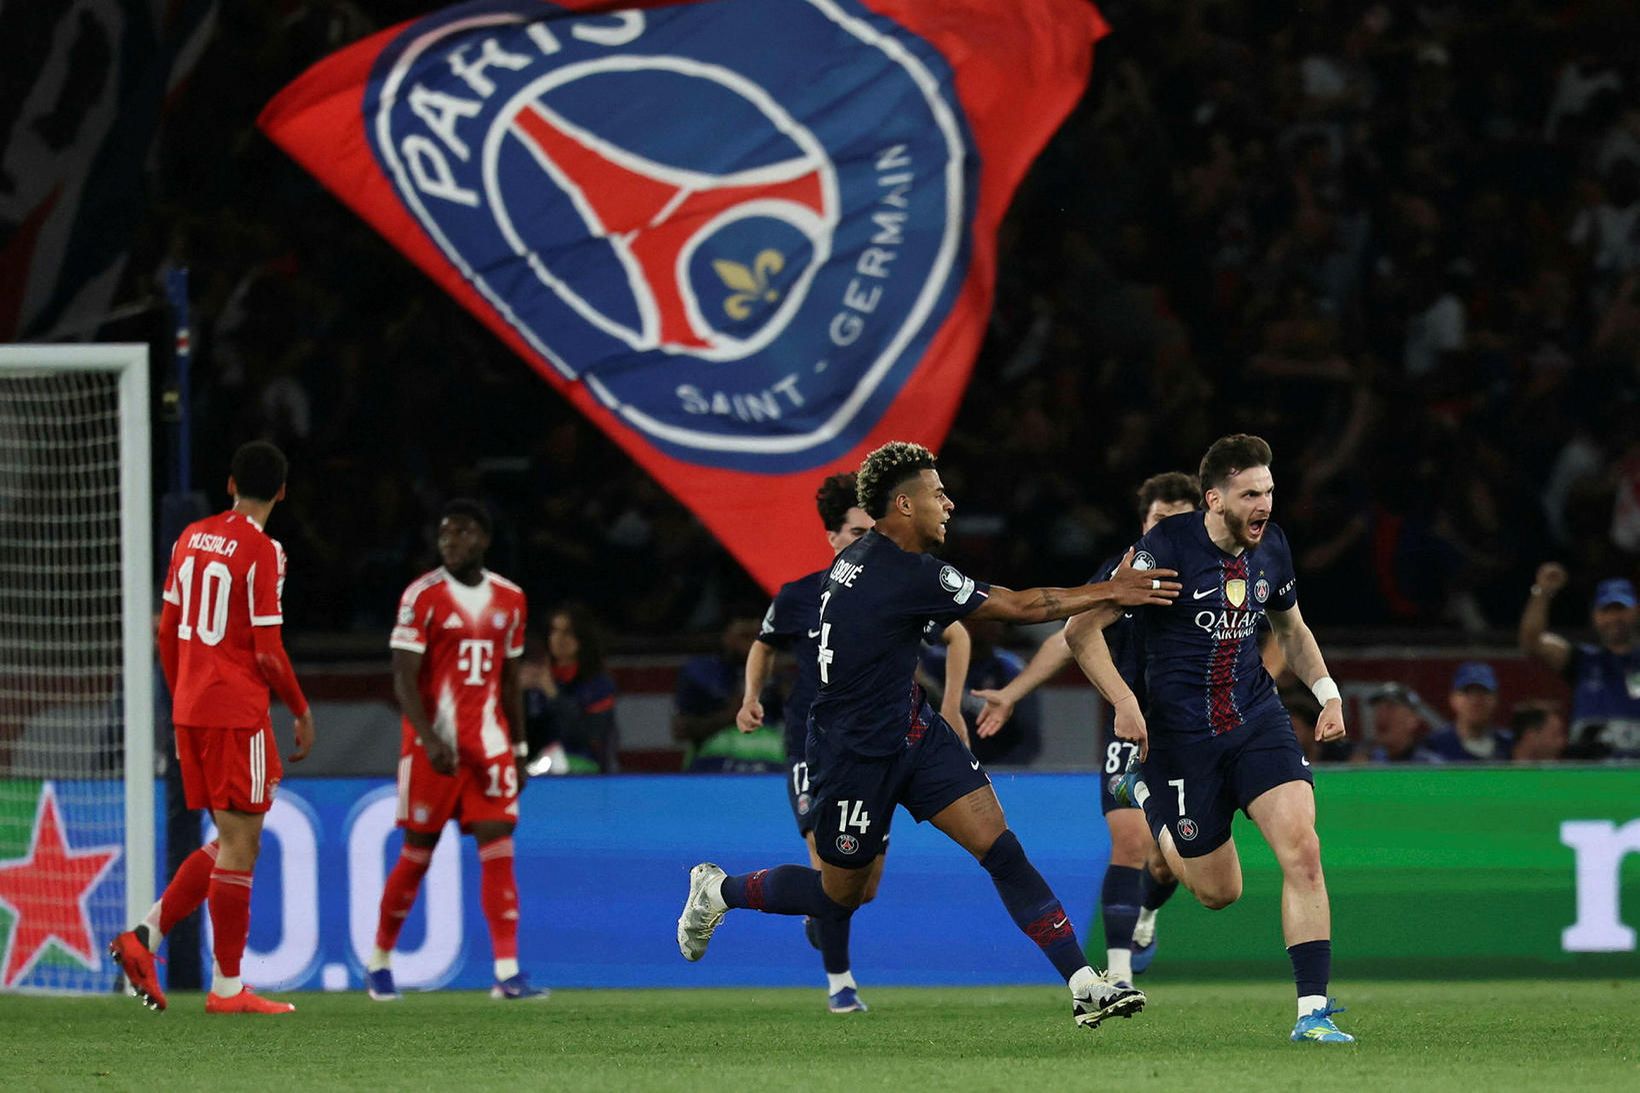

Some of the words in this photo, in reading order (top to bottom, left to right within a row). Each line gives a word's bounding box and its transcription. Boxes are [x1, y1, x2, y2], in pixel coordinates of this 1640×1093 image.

[676, 373, 804, 422] SAINT
[829, 144, 914, 346] GERMAIN
[178, 555, 232, 646] 10
[458, 639, 494, 686] T
[1105, 741, 1139, 774] 87
[486, 764, 518, 798] 19
[1168, 778, 1186, 816] 7
[837, 800, 871, 834] 14
